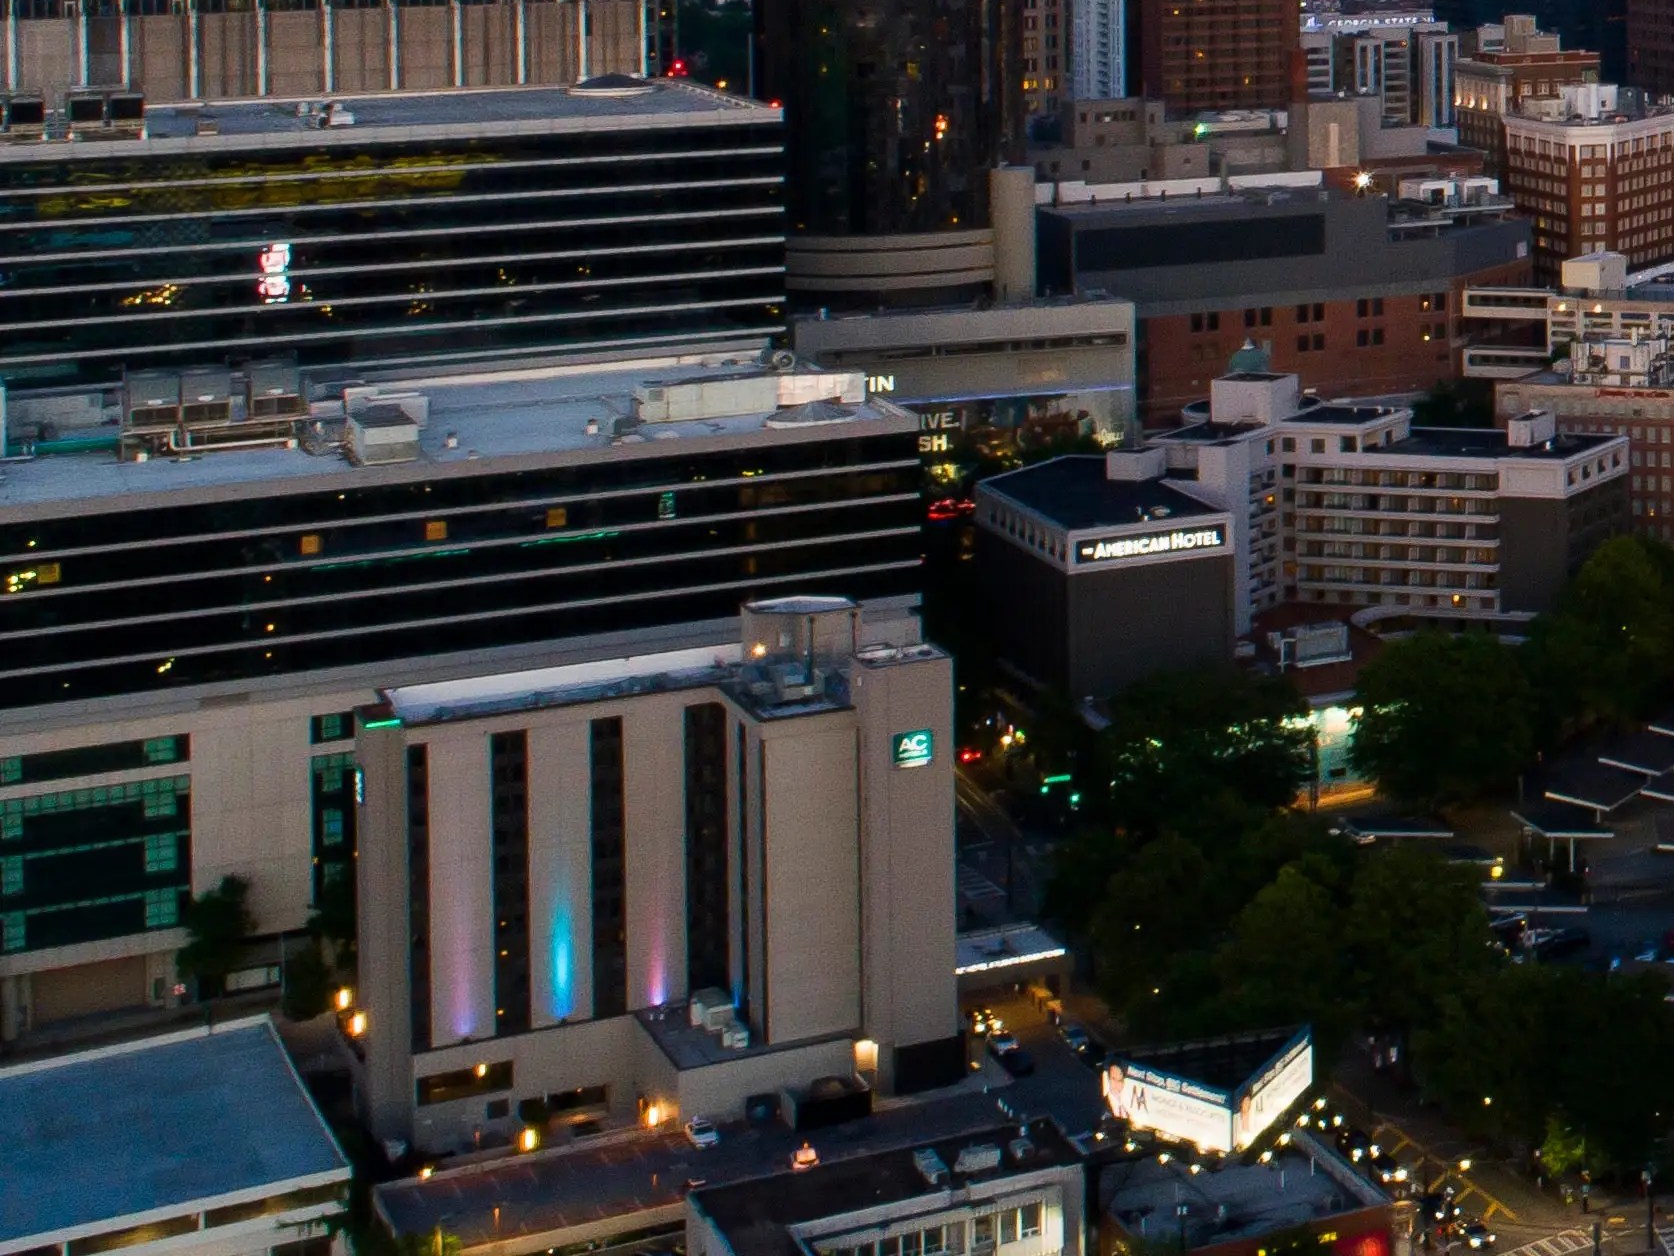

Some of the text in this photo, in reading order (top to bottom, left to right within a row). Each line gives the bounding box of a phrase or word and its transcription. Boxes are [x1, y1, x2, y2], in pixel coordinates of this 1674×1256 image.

[864, 375, 894, 392] IN
[1094, 531, 1220, 559] AMERICAN HOTEL
[899, 734, 928, 752] AC
